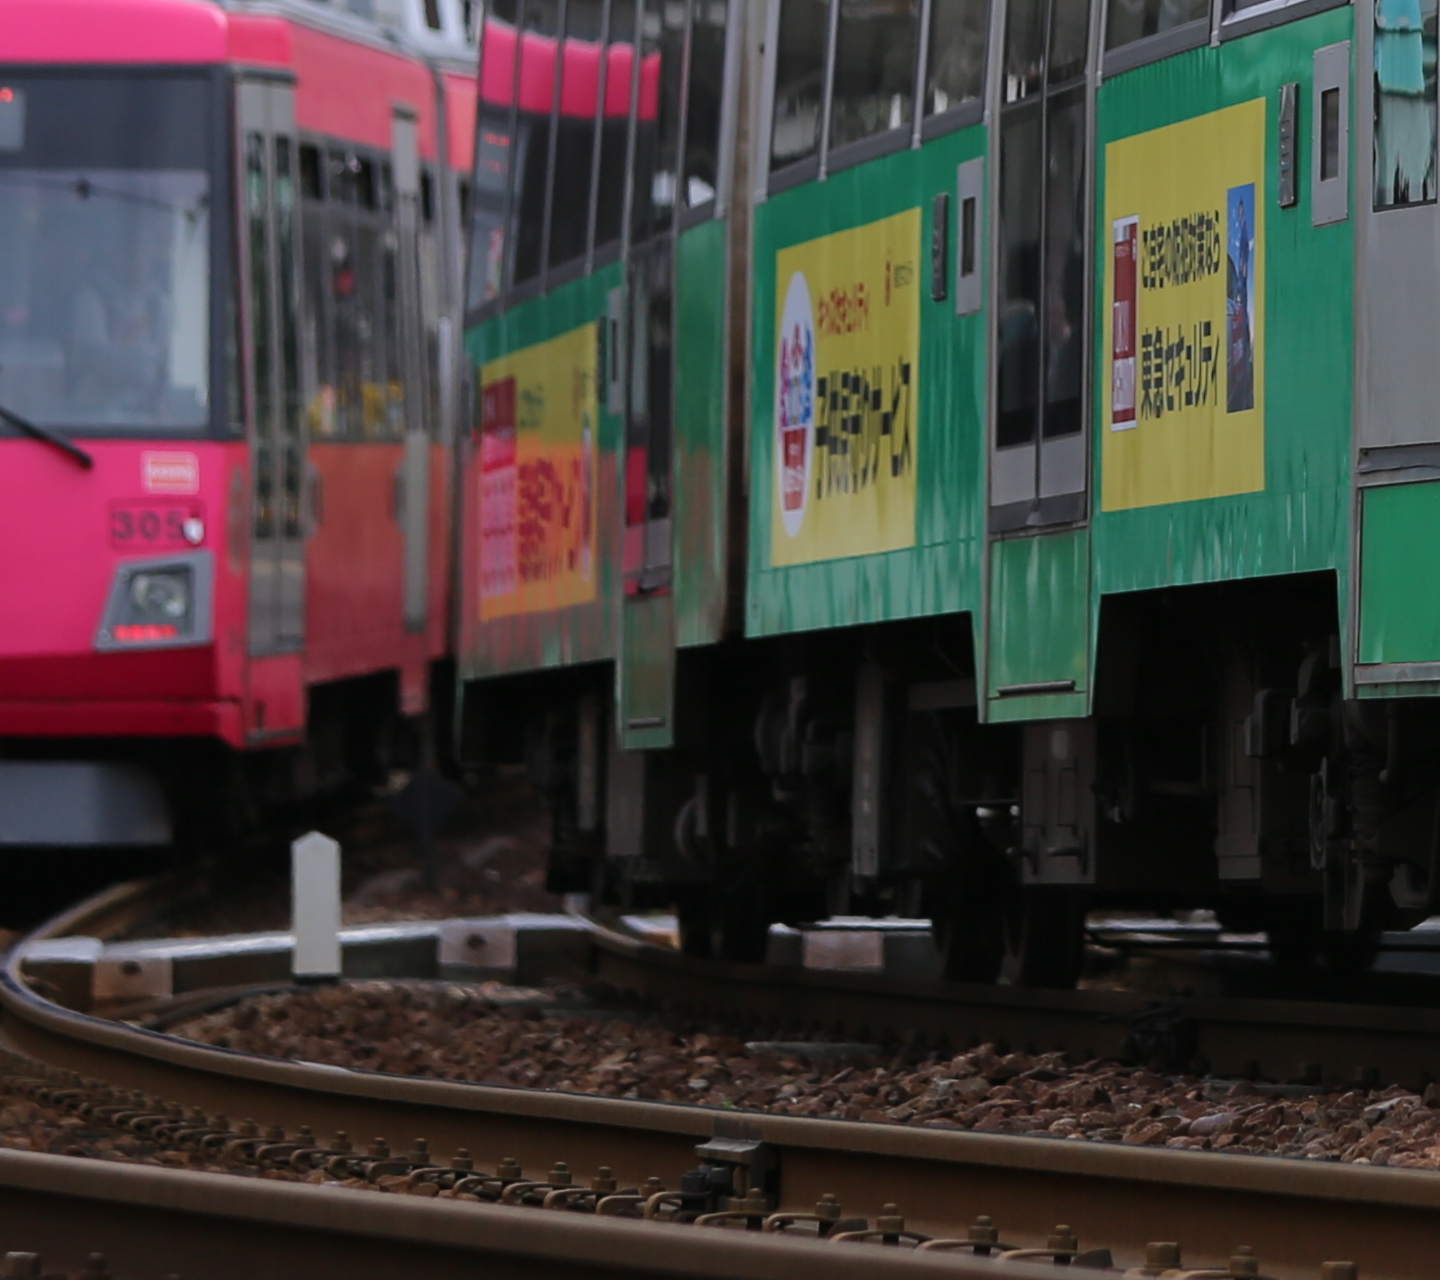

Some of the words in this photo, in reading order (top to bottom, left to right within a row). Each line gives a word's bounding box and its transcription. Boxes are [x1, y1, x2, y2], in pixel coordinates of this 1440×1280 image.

[1141, 320, 1220, 419] 東急セキュリティ
